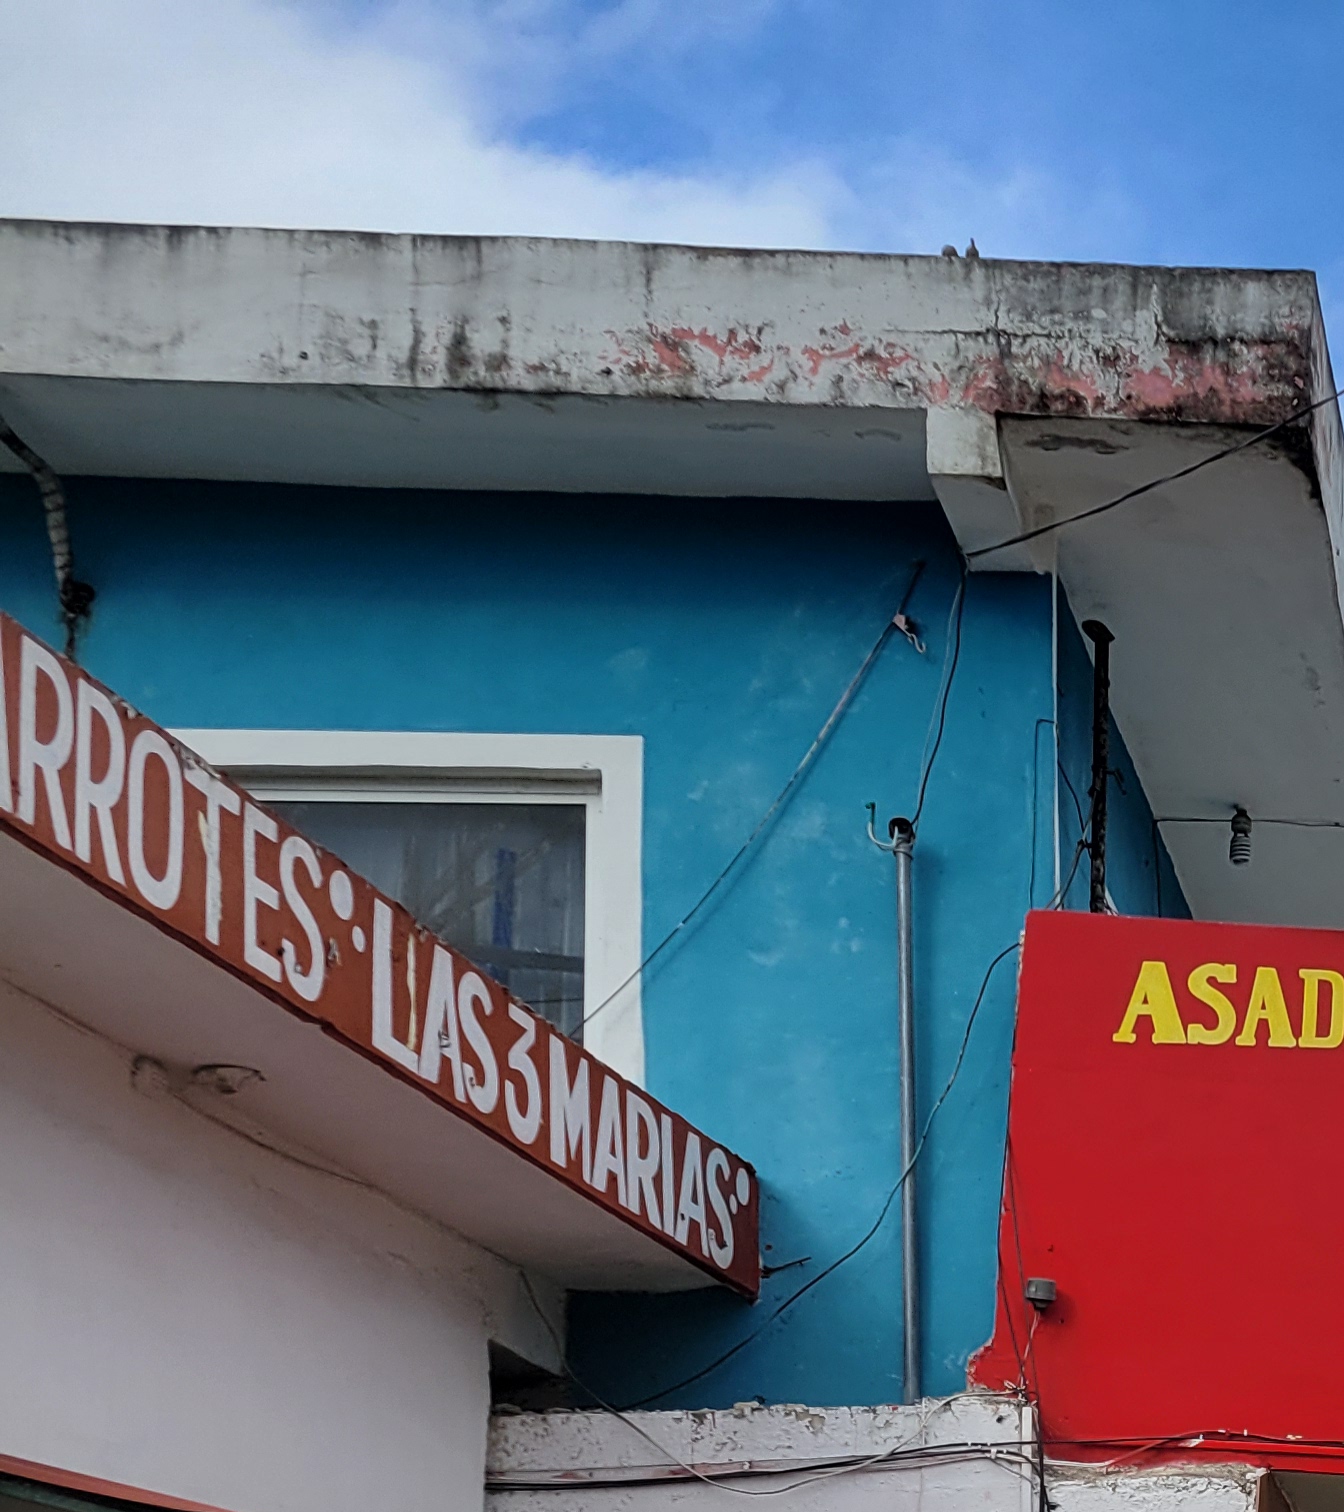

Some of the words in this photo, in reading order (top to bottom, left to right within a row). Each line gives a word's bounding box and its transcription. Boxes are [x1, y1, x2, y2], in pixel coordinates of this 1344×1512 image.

[0, 634, 326, 1002] RROTES
[372, 898, 499, 1115] LAS
[504, 1003, 542, 1145] 3
[550, 1034, 734, 1270] MARIAS
